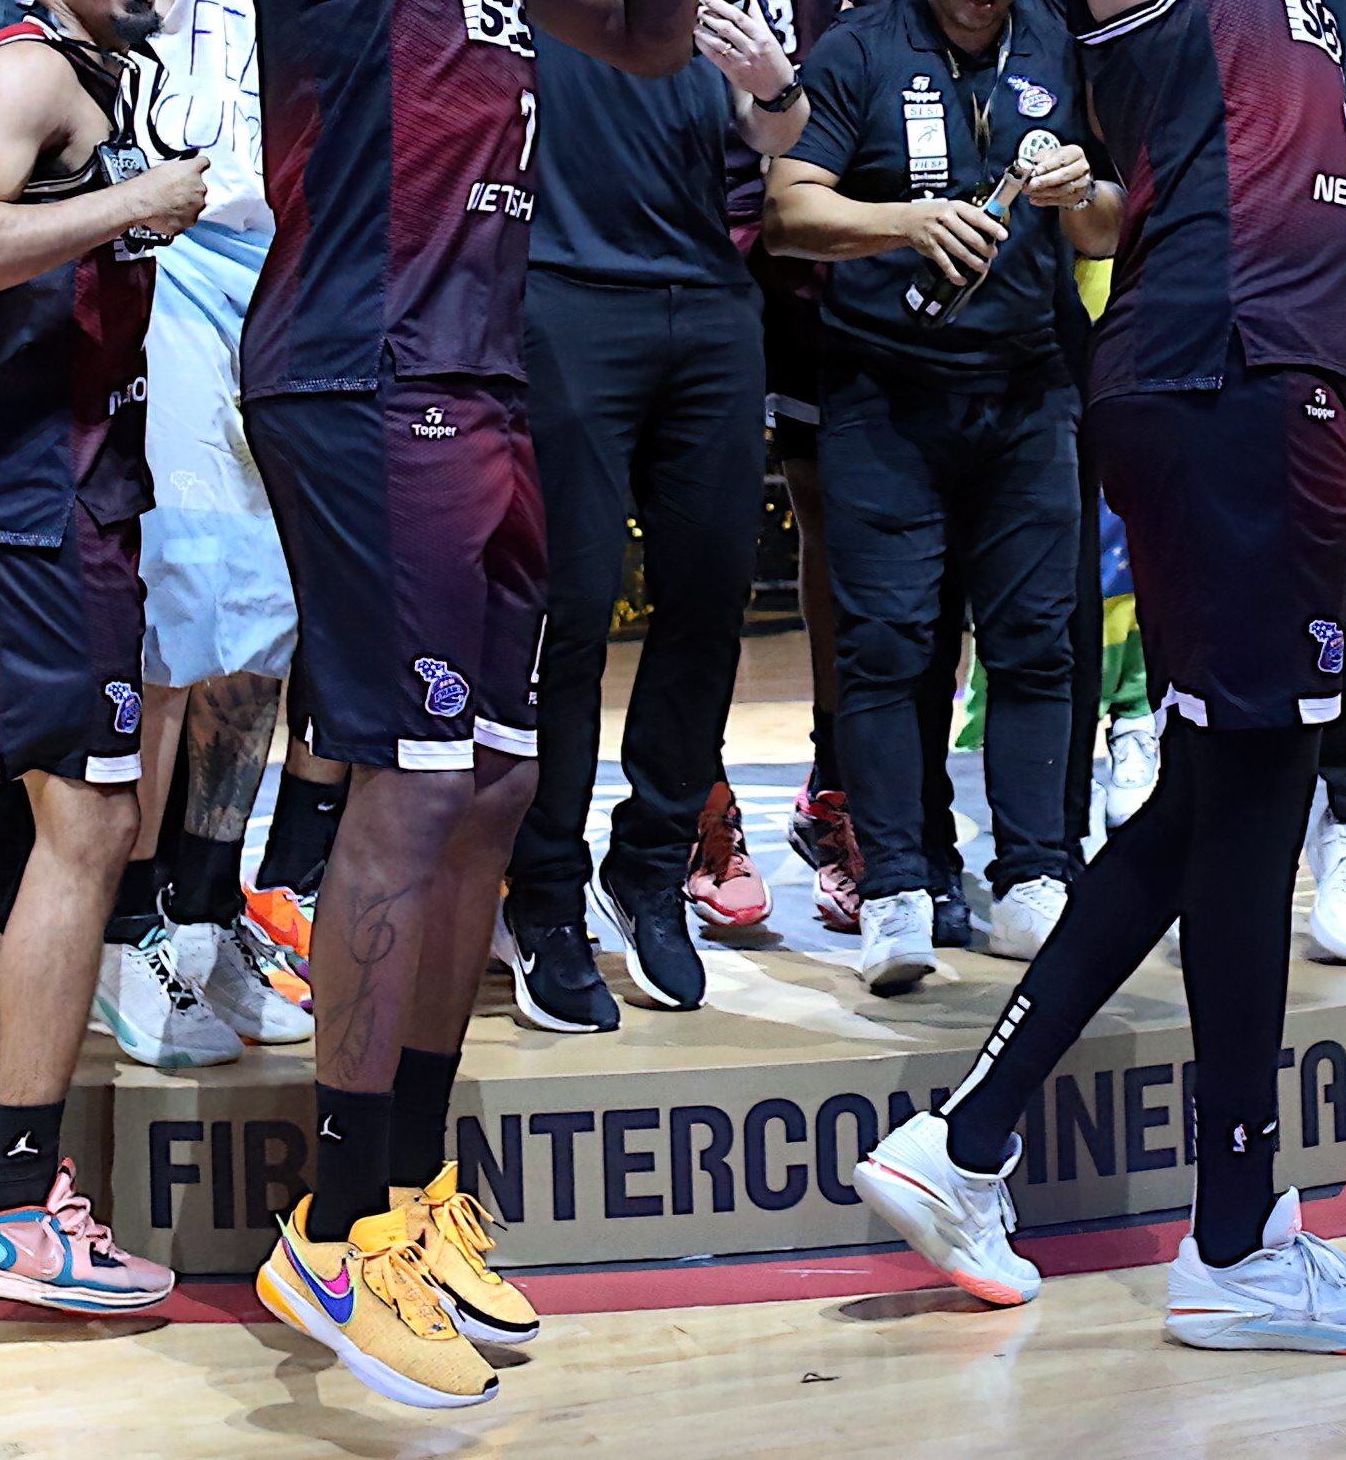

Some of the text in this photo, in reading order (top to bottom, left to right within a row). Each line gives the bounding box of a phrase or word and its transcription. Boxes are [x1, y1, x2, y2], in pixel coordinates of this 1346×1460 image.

[1304, 404, 1336, 421] Topper
[411, 423, 458, 440] Topper
[147, 1117, 312, 1231] FIB
